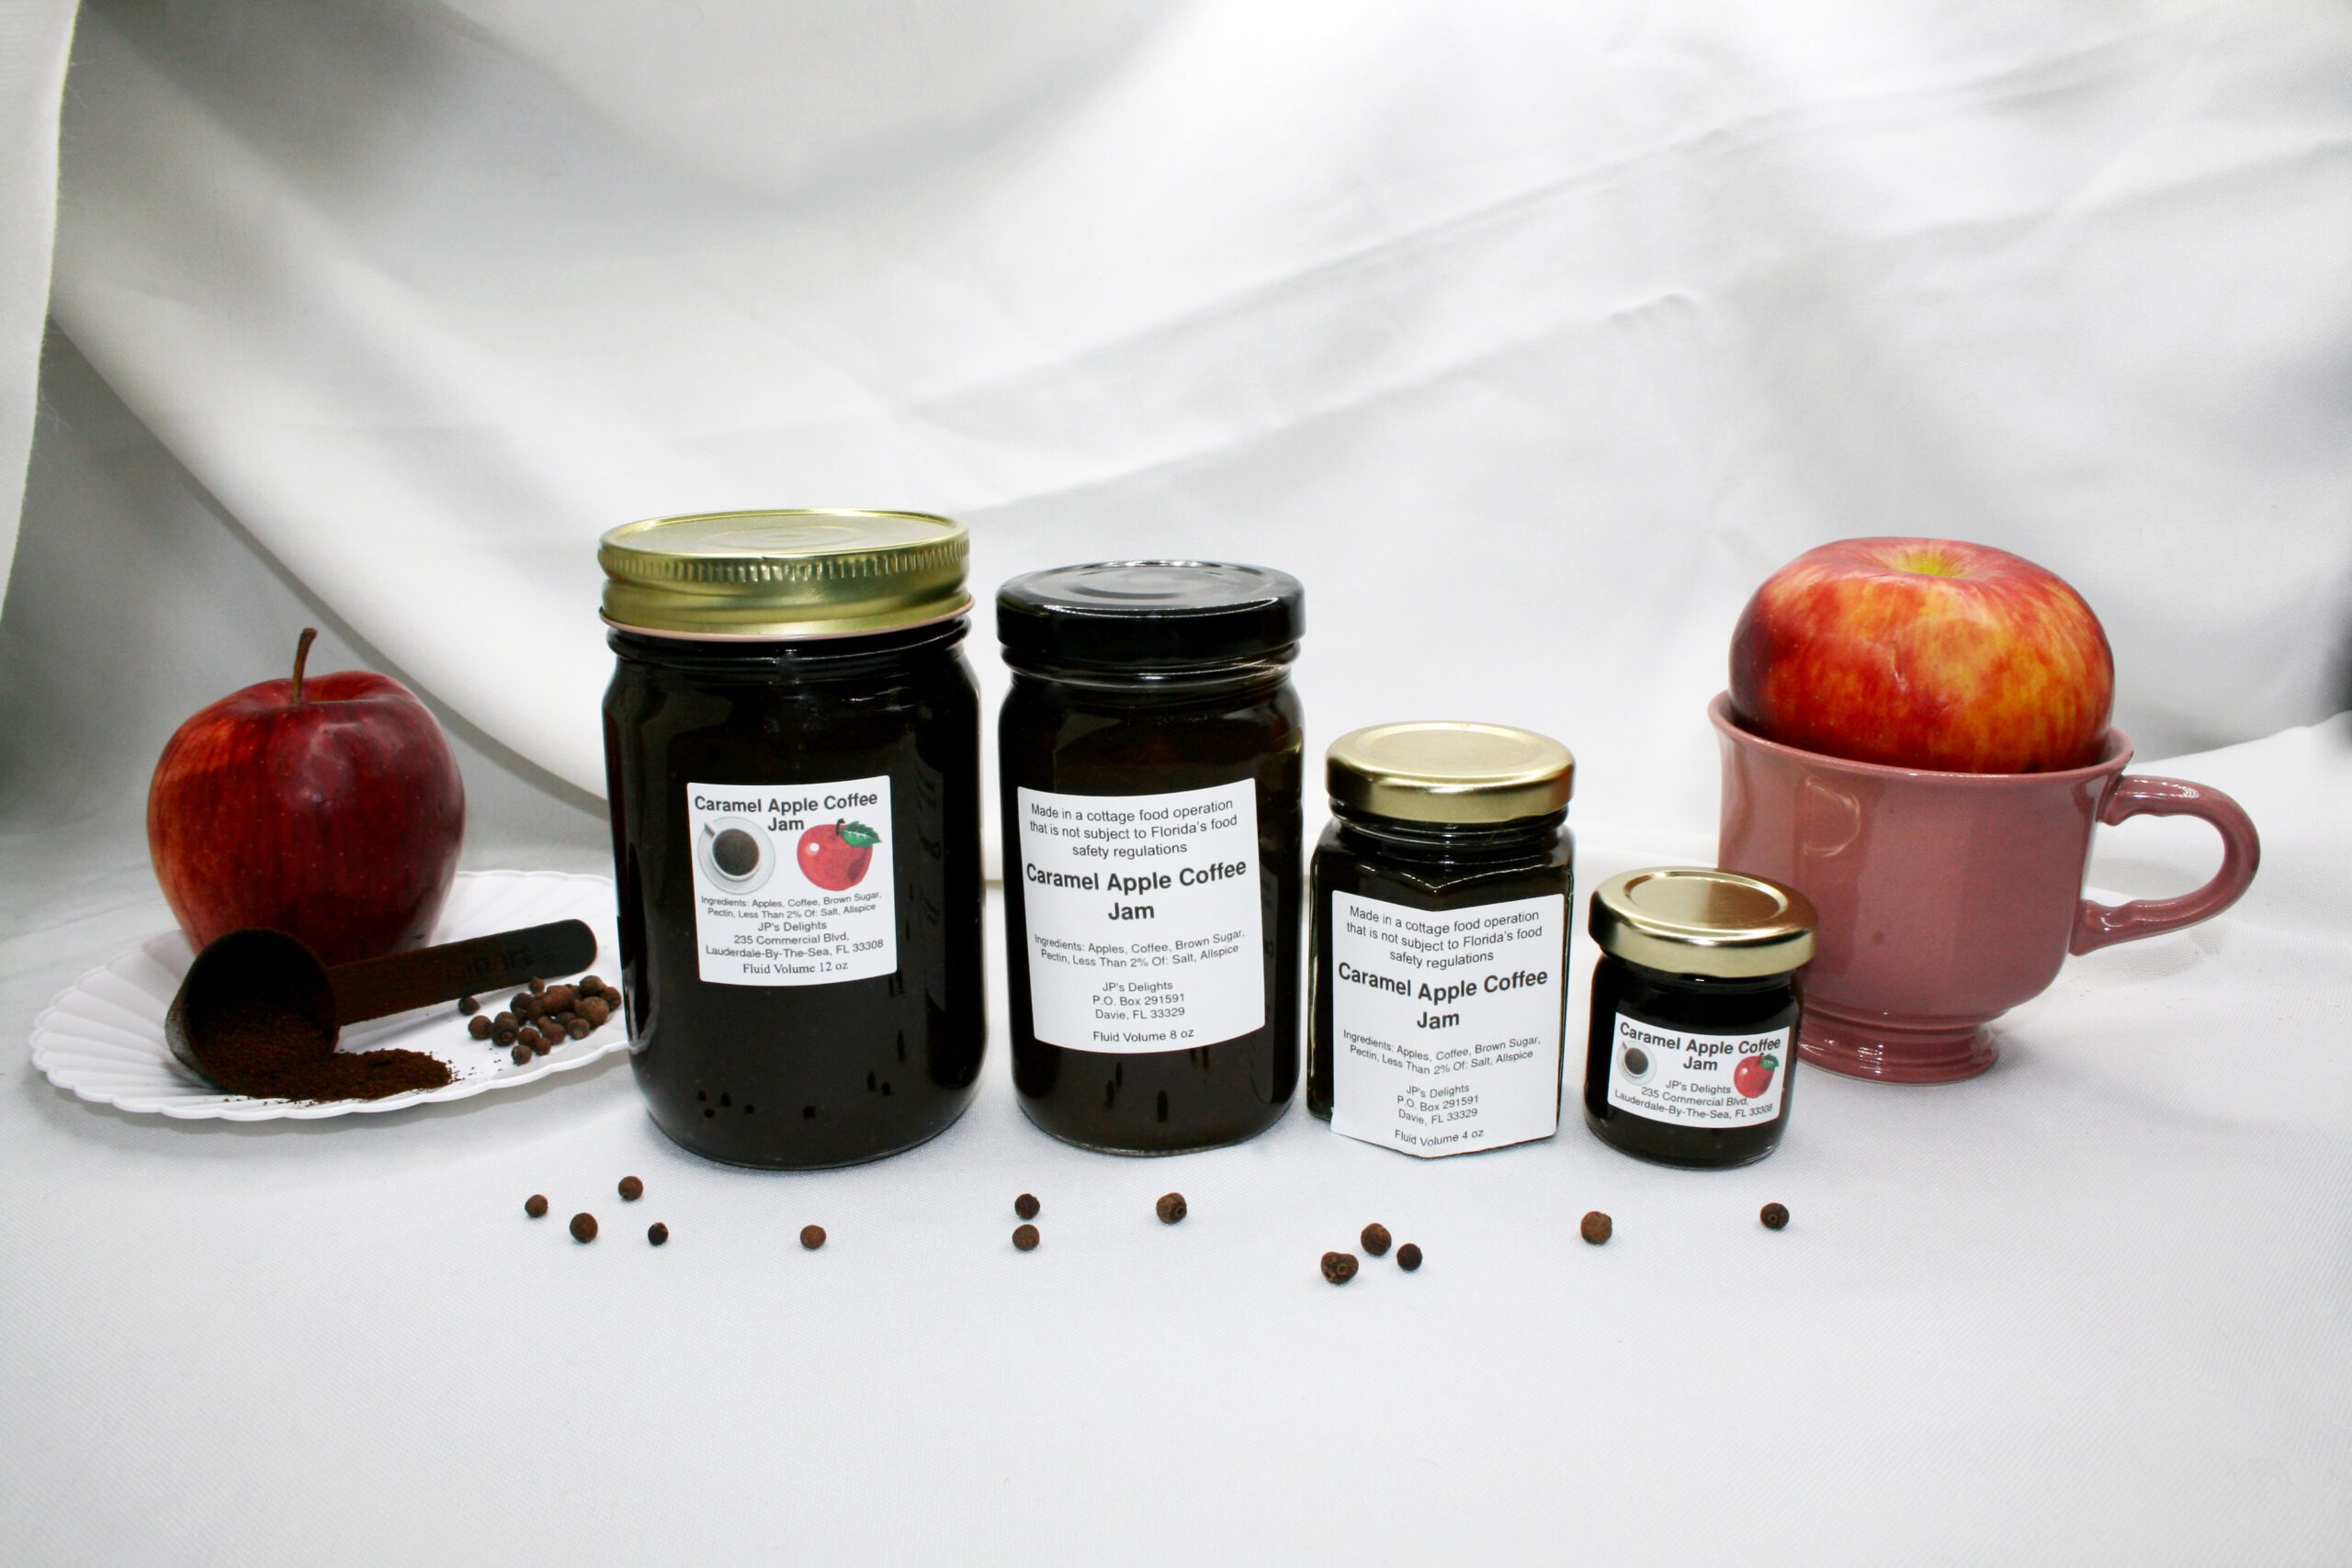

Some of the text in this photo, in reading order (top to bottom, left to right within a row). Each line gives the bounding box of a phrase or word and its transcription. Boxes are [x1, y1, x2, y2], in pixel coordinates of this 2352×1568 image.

[695, 794, 878, 816] Caramel Apple Coffee
[1031, 800, 1233, 825] Made in a cottage food operation
[767, 818, 805, 831] Jam
[1030, 816, 1238, 842] that is not subject to Florida's food
[1072, 843, 1188, 860] safety regulations
[1026, 861, 1247, 896] Caramel Apple Coffee
[823, 896, 852, 906] Brown
[738, 910, 759, 919] Less
[762, 910, 784, 919] Than
[786, 910, 802, 919] 2%
[842, 903, 876, 915] Allspice
[1107, 902, 1155, 920] Jam
[783, 921, 827, 933] Delights
[1350, 905, 1539, 937] Made in a cottage food operation
[734, 935, 752, 944] 235
[756, 935, 820, 944] Commercial
[1035, 929, 1246, 955] Ingredients: Apples, Coffee, Brown Sugar,
[1347, 922, 1543, 952] that is not subject to Florida's food
[836, 945, 849, 954] FL
[853, 940, 884, 953] 33308
[1041, 943, 1238, 967] Pectin, Less Than 2% Of: Salt, Allspice
[742, 964, 771, 974] Fluid
[774, 964, 815, 974] Volume
[820, 963, 831, 972] 12
[1389, 952, 1494, 970] safety regulations
[1102, 981, 1173, 994] JP's Delights
[1339, 962, 1548, 1006] Caramel Apple Coffee
[1093, 994, 1185, 1007] P.O. Box 291591
[1095, 1008, 1185, 1021] Davie, FL 33329
[1417, 1011, 1460, 1030] Jam
[1093, 1030, 1194, 1043] Fluid Volume 8 oz
[1620, 1021, 1781, 1057] Caramel Apple Coffee
[1475, 1041, 1506, 1054] Brown
[1382, 1055, 1403, 1068] Less
[1407, 1061, 1430, 1075] Than
[1433, 1065, 1450, 1075] 2%
[1496, 1050, 1533, 1065] Allspice
[1683, 1056, 1718, 1071] Jam
[1406, 1083, 1470, 1099] JP's Delights
[1641, 1087, 1659, 1098] 235
[1662, 1091, 1724, 1107] Commercial
[1690, 1083, 1732, 1095] Delights
[1397, 1095, 1478, 1112] P.O. Box 291591
[1430, 1113, 1443, 1124] FL
[1446, 1108, 1478, 1122] 33329
[1735, 1109, 1747, 1118] FL
[1395, 1130, 1417, 1145] Fluid
[1419, 1133, 1459, 1146] Volume
[1471, 1129, 1485, 1138] oz
